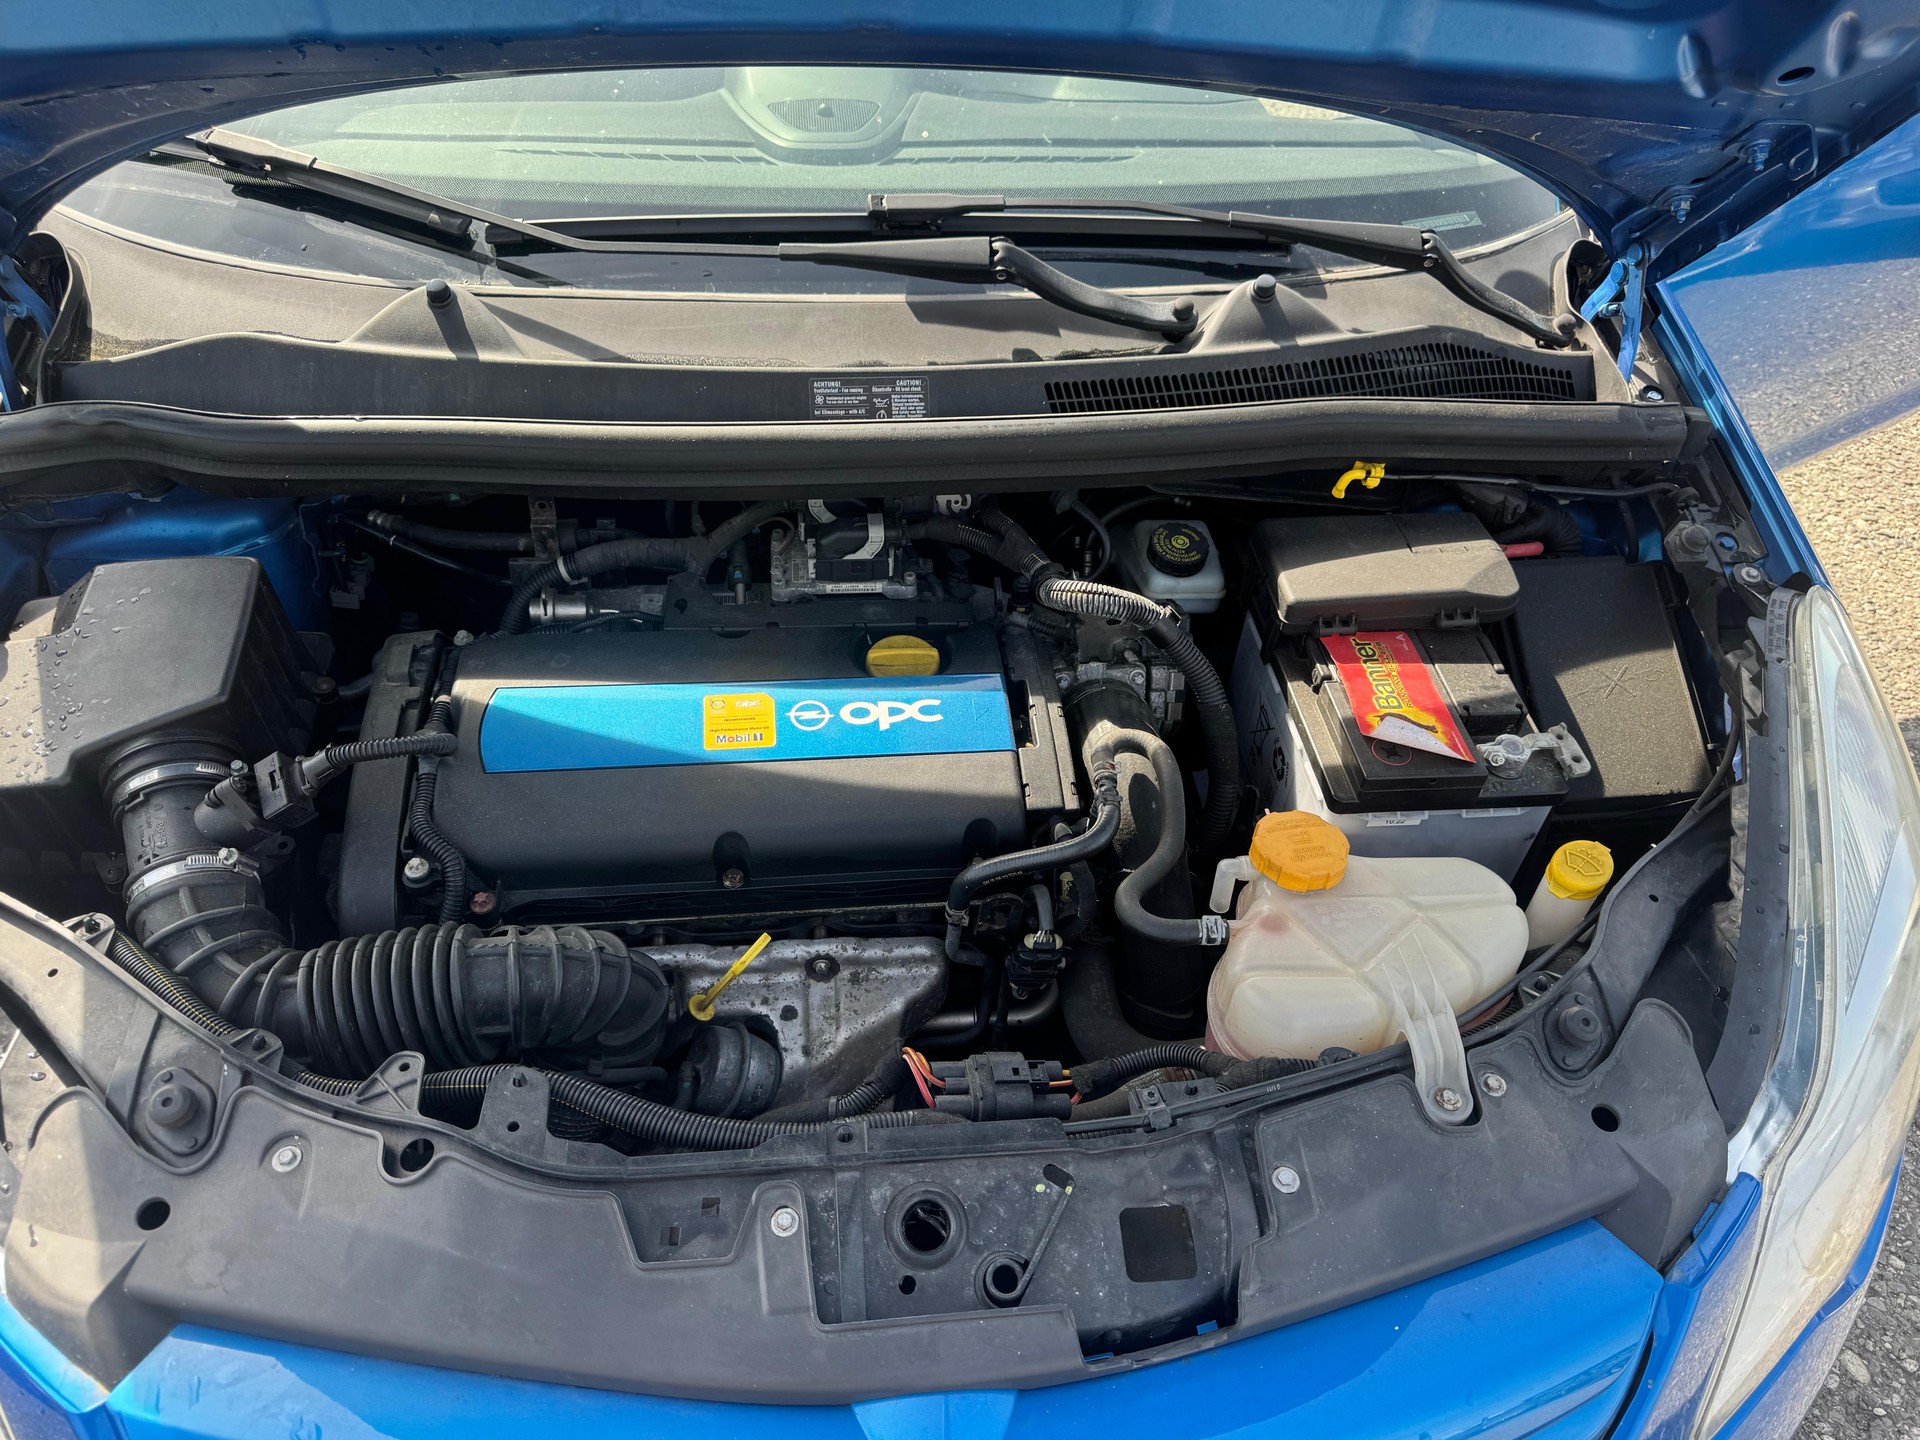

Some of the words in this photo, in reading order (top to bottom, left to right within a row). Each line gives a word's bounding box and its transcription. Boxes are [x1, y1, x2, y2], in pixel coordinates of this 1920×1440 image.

[1182, 528, 1200, 541] WARNING
[1352, 638, 1402, 710] Banner
[717, 734, 750, 743] Mobil
